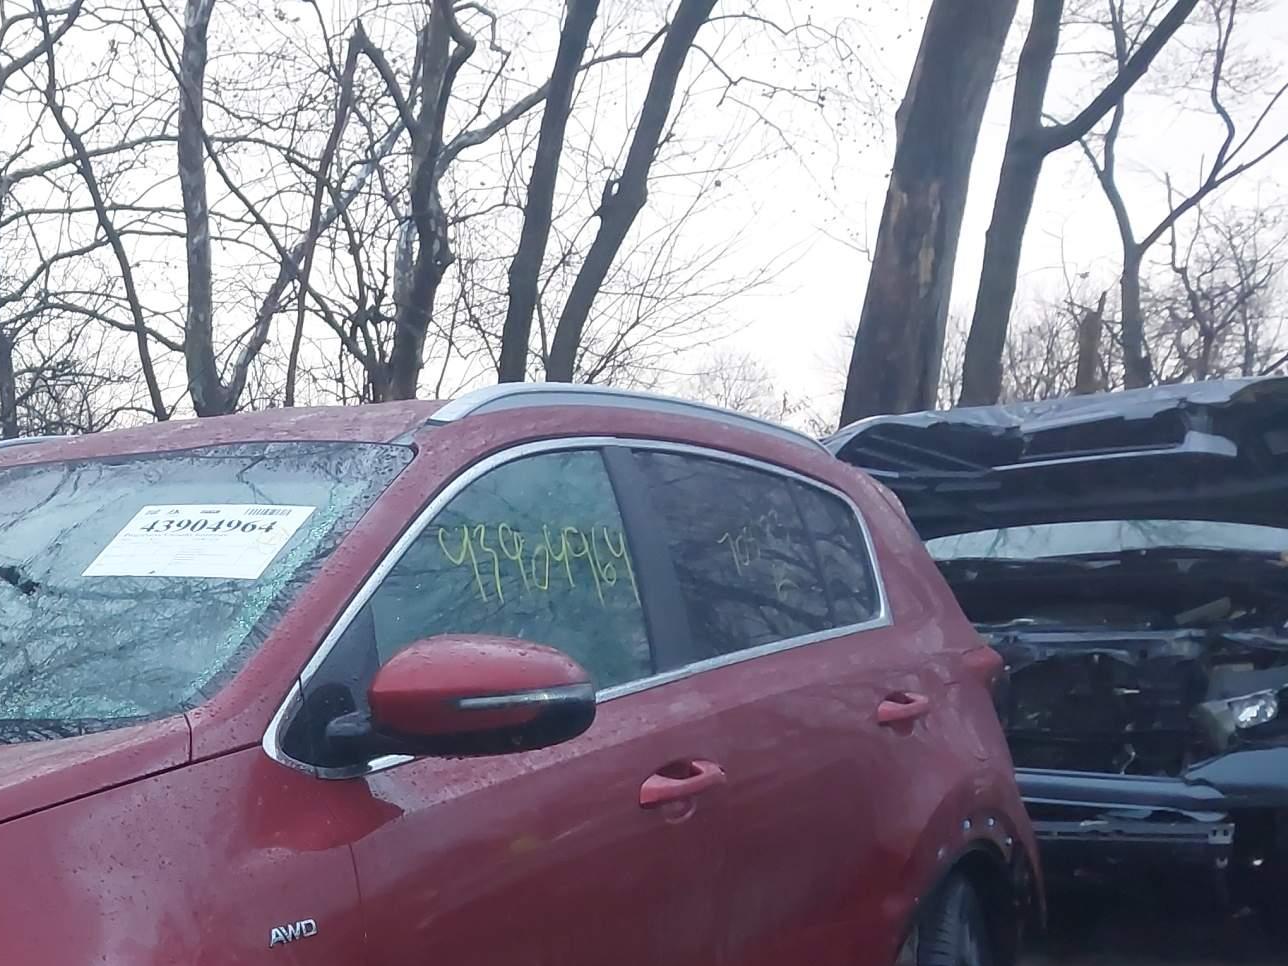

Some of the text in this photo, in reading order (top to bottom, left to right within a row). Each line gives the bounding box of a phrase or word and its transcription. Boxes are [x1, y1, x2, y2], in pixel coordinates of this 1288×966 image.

[140, 518, 278, 533] 43904964
[438, 522, 642, 607] 43904964
[269, 919, 318, 948] AWD
